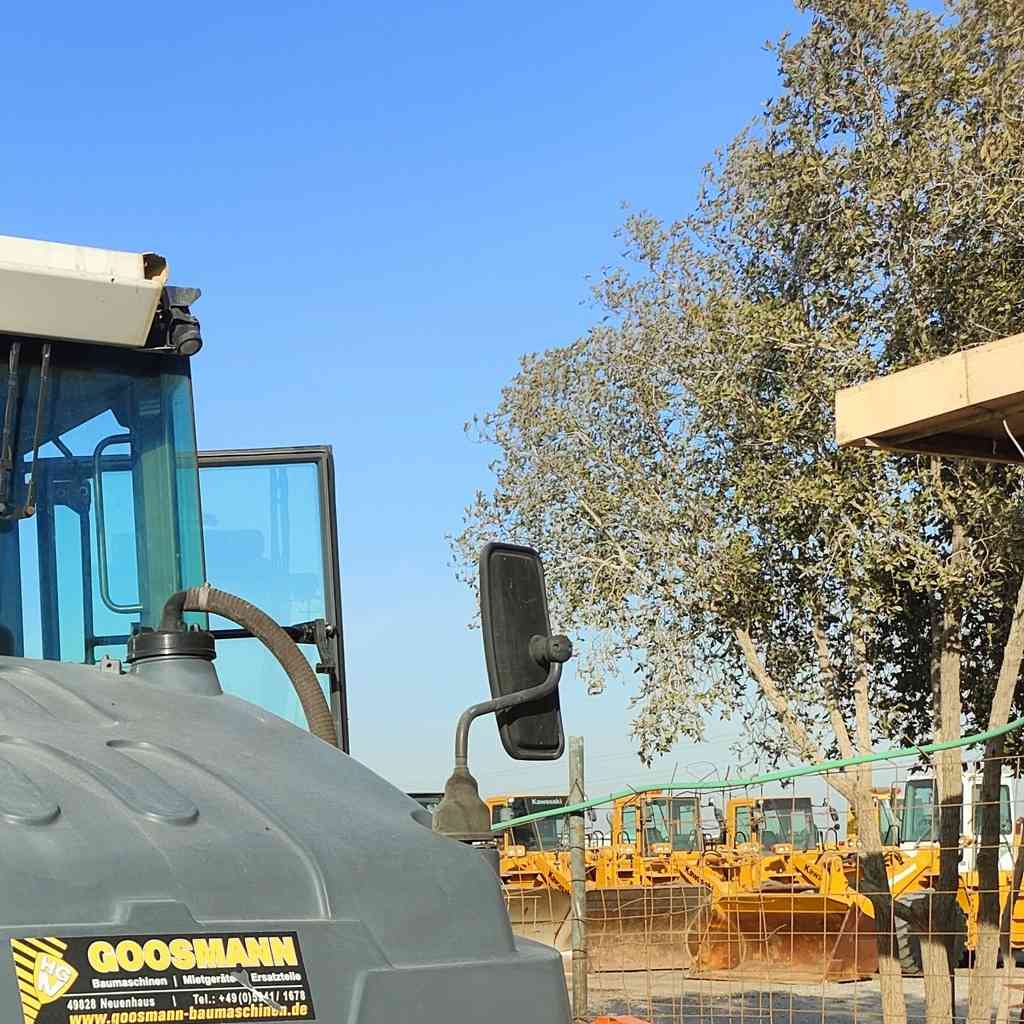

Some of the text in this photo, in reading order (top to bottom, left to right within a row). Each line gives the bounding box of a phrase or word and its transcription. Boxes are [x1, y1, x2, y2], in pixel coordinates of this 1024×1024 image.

[87, 936, 298, 973] GOOSMANN
[91, 976, 168, 989] Baumaschinen
[250, 971, 302, 983] Ersatzteile
[66, 999, 97, 1011] 49828
[100, 997, 155, 1009] Neuenhaus
